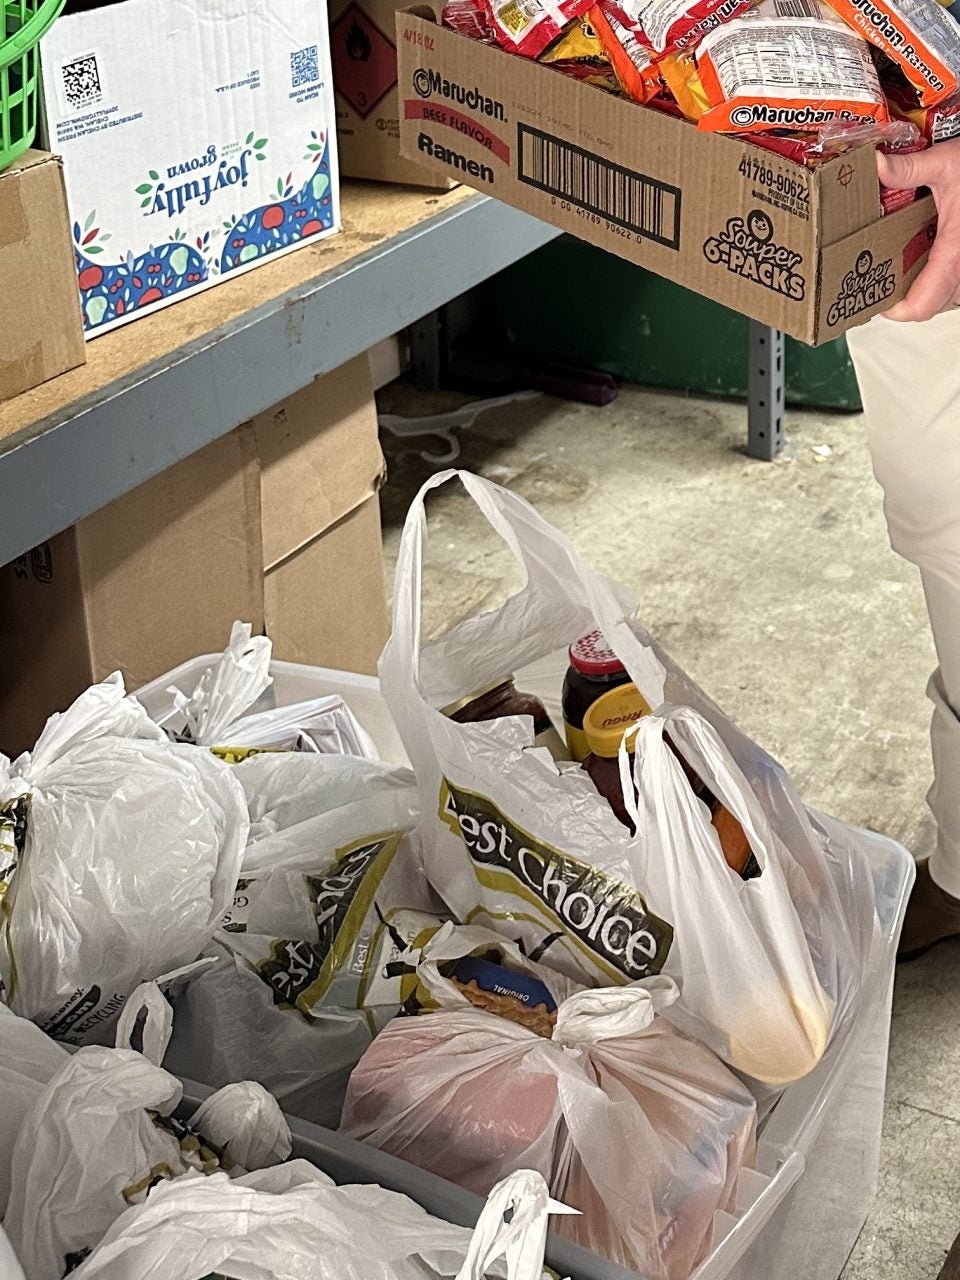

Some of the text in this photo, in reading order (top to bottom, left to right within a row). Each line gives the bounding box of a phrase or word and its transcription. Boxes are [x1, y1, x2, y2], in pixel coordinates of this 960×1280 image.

[854, 13, 886, 50] Chicken
[237, 76, 260, 87] PRODUCE
[902, 44, 945, 92] Ramen
[305, 91, 319, 101] SCAN
[307, 82, 325, 93] LEARN
[357, 92, 367, 107] 3
[77, 125, 100, 136] CHELAN
[108, 112, 143, 128] DISTRIBUTED
[423, 107, 493, 151] BEEF FLAVOR
[751, 105, 835, 125] Maruchan
[57, 132, 76, 143] FRESH
[166, 144, 217, 179] grown
[417, 132, 495, 184] Ramen
[150, 149, 252, 218] joyfully
[738, 158, 811, 204] 41789-90622
[767, 188, 796, 207] PRODUCT OF
[551, 196, 556, 205] 0
[576, 207, 600, 225] 41789
[605, 221, 631, 240] 90622
[636, 233, 642, 244] 0
[719, 216, 802, 268] Souper
[702, 235, 806, 302] 6-PACKS
[838, 258, 893, 301] Souper
[826, 273, 896, 328] 6-PACKS
[518, 847, 657, 970] Choice
[352, 942, 370, 973] Best
[493, 984, 530, 1002] ORIGINAL
